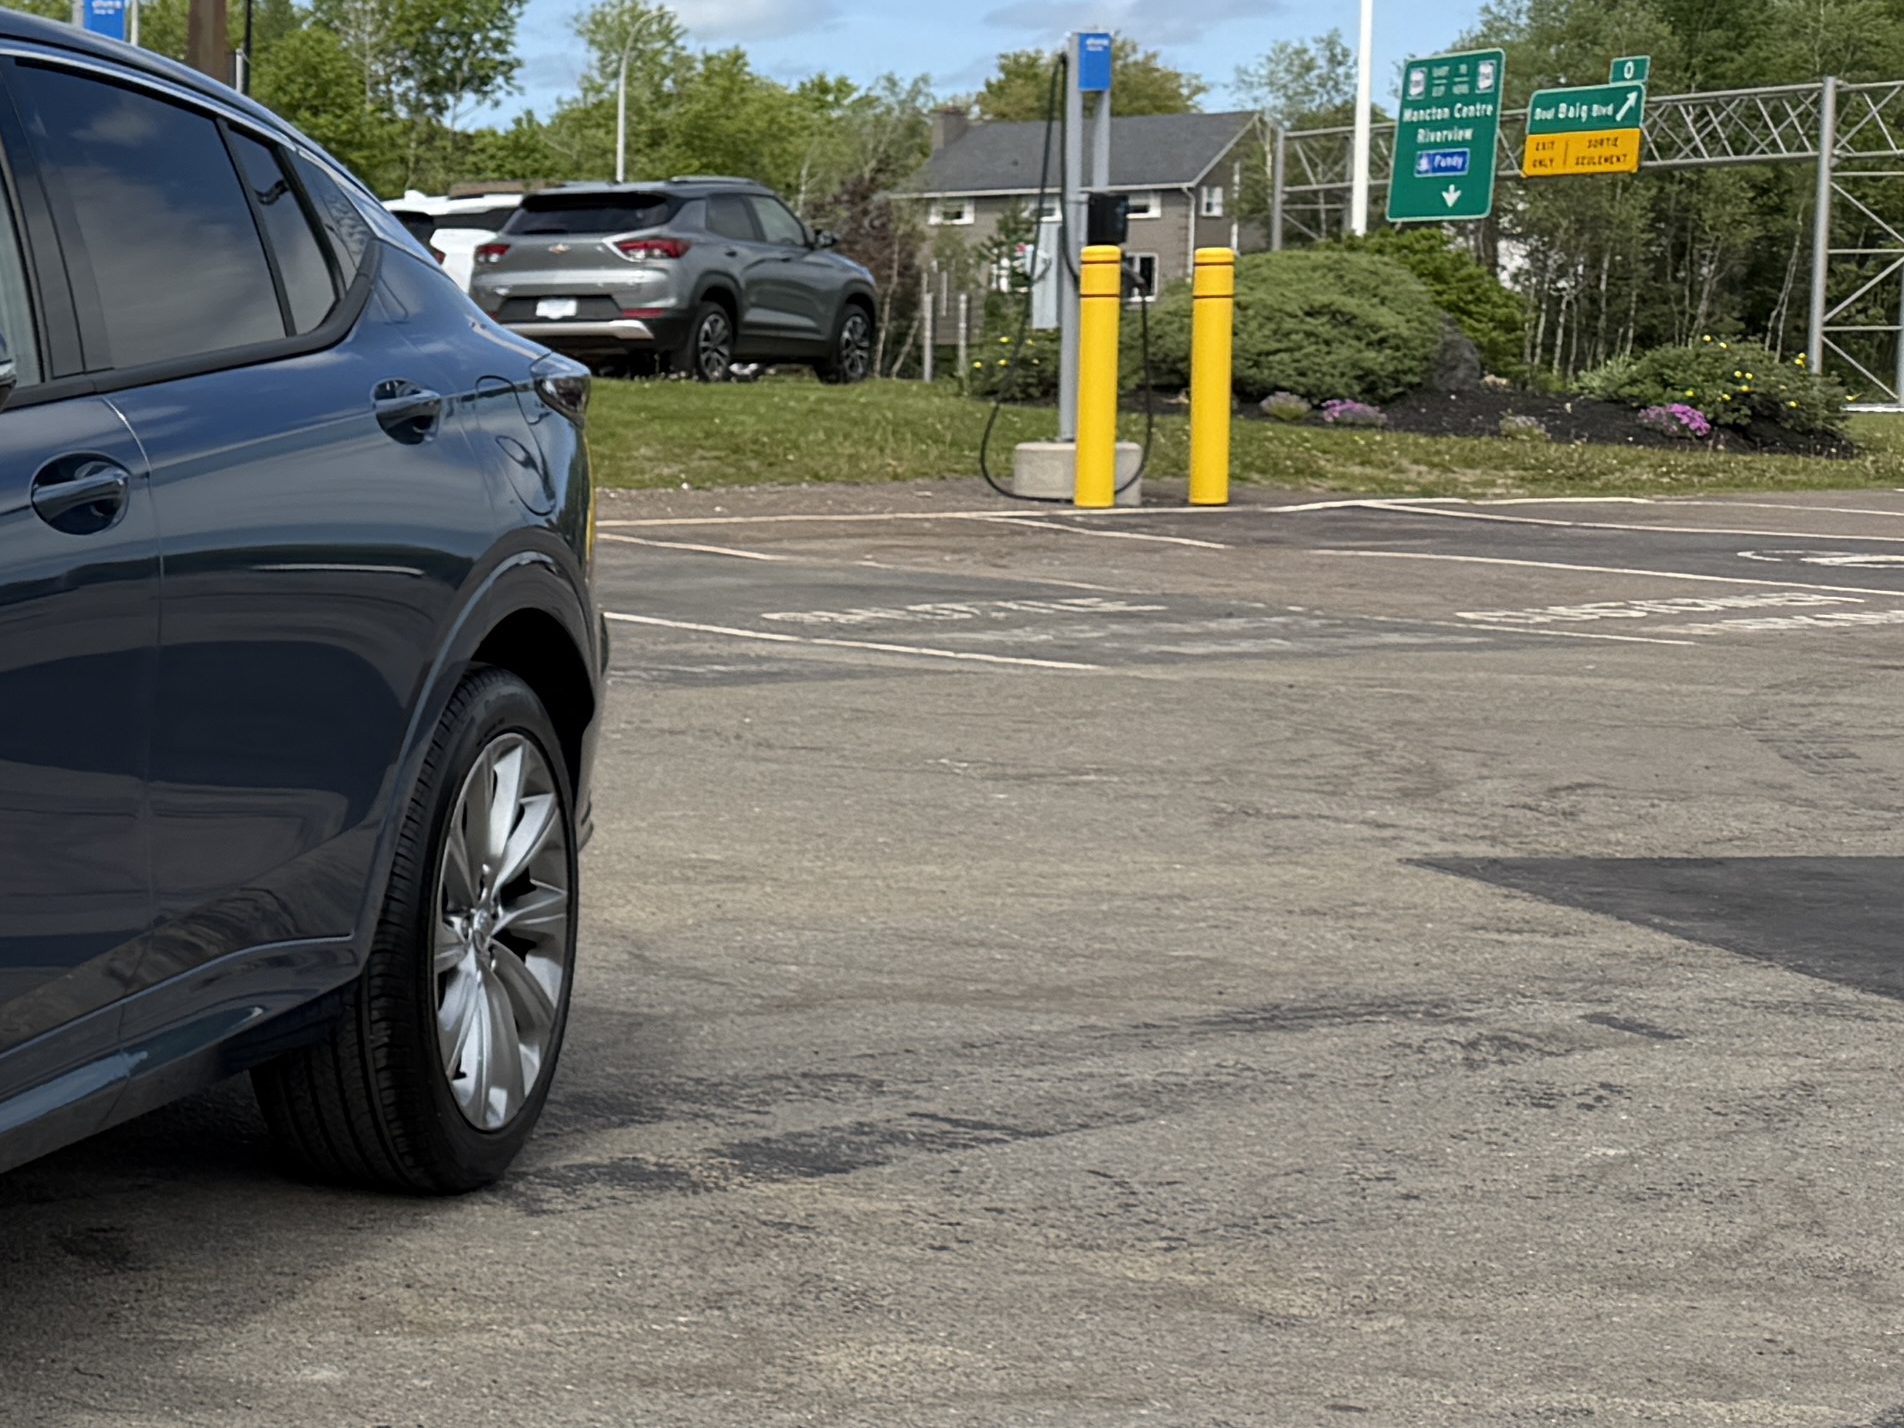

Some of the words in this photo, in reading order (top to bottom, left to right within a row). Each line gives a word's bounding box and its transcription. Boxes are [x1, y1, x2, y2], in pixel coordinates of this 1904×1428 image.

[1453, 102, 1493, 118] Centre
[1558, 102, 1588, 123] Baig
[1416, 126, 1473, 143] Riverview
[1535, 141, 1555, 151] EXIT
[1587, 137, 1619, 149] SORTIE
